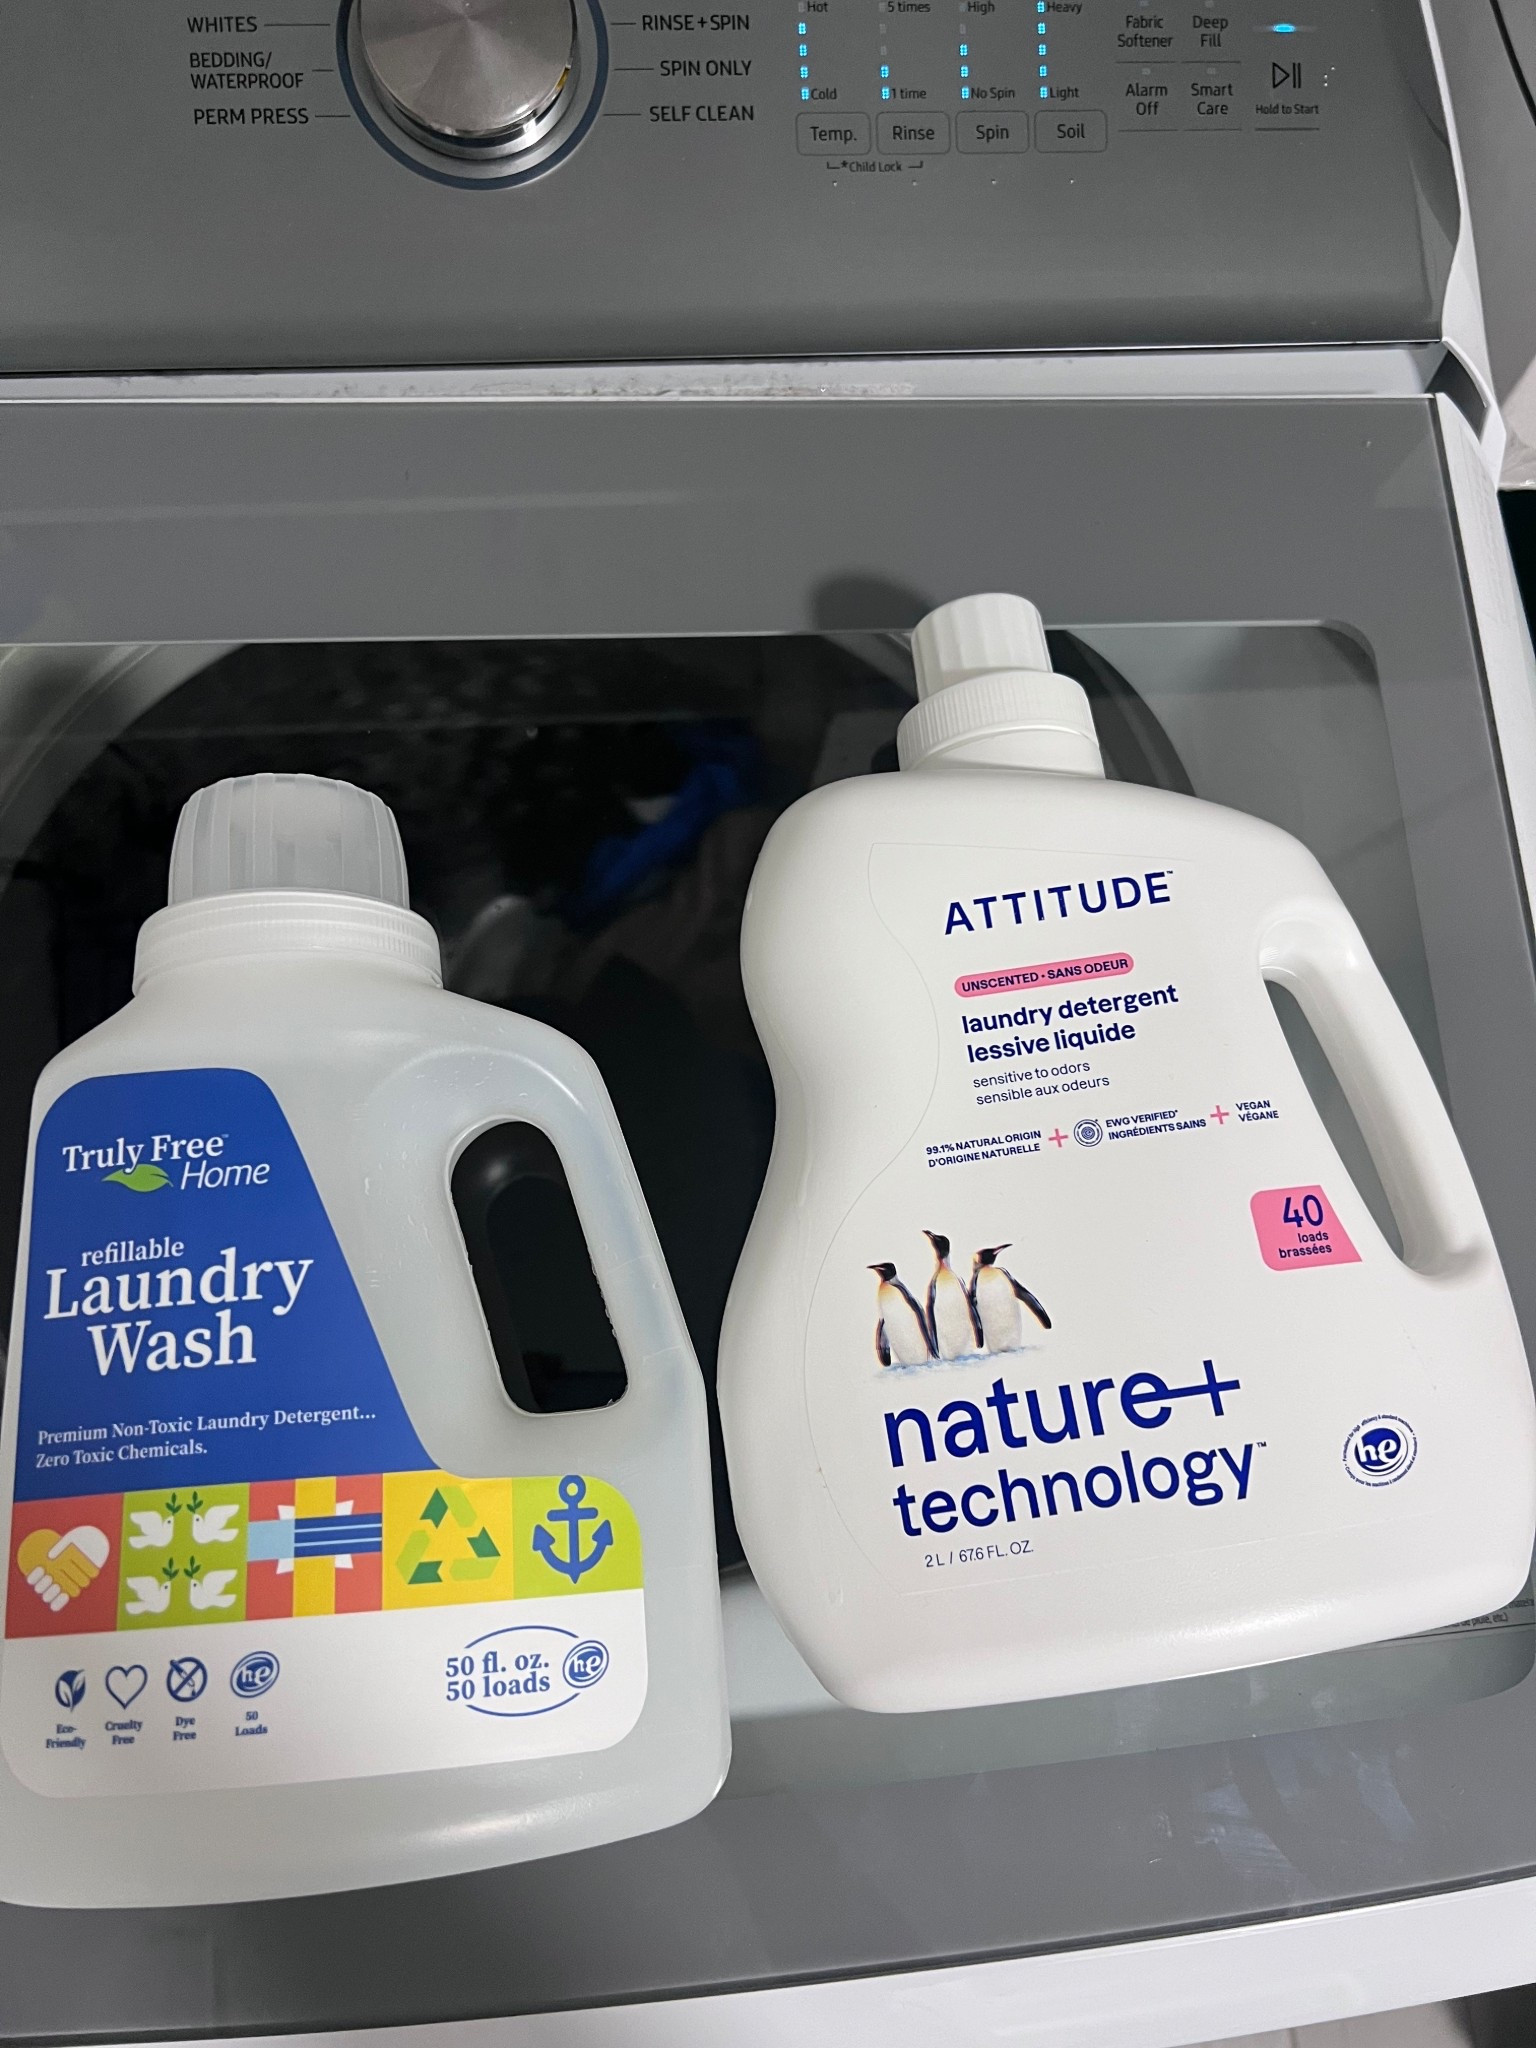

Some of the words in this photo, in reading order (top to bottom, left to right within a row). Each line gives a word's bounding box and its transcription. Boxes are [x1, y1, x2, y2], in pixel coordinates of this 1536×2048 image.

[807, 2, 828, 13] Hot
[888, 1, 895, 13] 5
[898, 1, 931, 13] times
[968, 1, 995, 15] High
[1047, 1, 1082, 15] Heavy
[187, 16, 258, 33] WHITES
[1125, 15, 1164, 29] Fabric
[1193, 15, 1229, 31] Deep
[1117, 33, 1173, 48] Softener
[1201, 33, 1222, 48] Fill
[190, 51, 272, 69] BEDDING/
[660, 60, 700, 76] SPIN
[706, 60, 752, 76] ONLY
[190, 72, 304, 89] WATERPROOF
[811, 88, 838, 100] Cold
[900, 88, 927, 99] time
[971, 87, 987, 99] No
[990, 87, 1015, 100] Spin
[1050, 86, 1079, 101] Light
[1125, 83, 1168, 97] Alarm
[1191, 83, 1233, 97] Smart
[194, 108, 245, 125] PERM
[251, 107, 309, 125] PRESS
[650, 106, 691, 122] SELF
[696, 105, 754, 121] CLEAN
[1136, 102, 1159, 115] Off
[1197, 102, 1229, 115] Care
[1256, 104, 1279, 114] Hold
[1282, 104, 1292, 114] to
[1294, 104, 1319, 114] Start
[810, 126, 857, 145] Temp.
[892, 125, 935, 140] Rinse
[976, 125, 1009, 143] Spin
[1057, 123, 1086, 139] Soil
[878, 161, 903, 172] Lock
[961, 972, 1039, 992] UNSCENTED
[1047, 965, 1082, 980] SANS
[1084, 958, 1129, 974] ODEUR
[962, 1005, 1053, 1034] laundry
[1058, 984, 1179, 1019] detergent
[967, 1035, 1050, 1063] lessive
[1053, 1023, 1136, 1051] liquide
[973, 1069, 1033, 1088] sensitive
[1034, 1067, 1049, 1079] to
[1051, 1060, 1090, 1077] odors
[976, 1086, 1033, 1105] sensible
[1035, 1084, 1060, 1097] aux
[1061, 1076, 1110, 1093] odeurs
[1236, 1100, 1271, 1111] VEGAN
[1106, 1117, 1130, 1128] EWG
[1238, 1110, 1279, 1122] VÉGANE
[1108, 1123, 1175, 1140] INGRÉDIENTS
[1176, 1118, 1207, 1131] SAINS
[926, 1143, 955, 1155] 99.1%
[955, 1136, 1005, 1152] NATURAL
[1005, 1130, 1041, 1143] ORIGIN
[62, 1138, 144, 1173] Truly
[928, 1151, 980, 1168] D'ORIGINE
[981, 1143, 1041, 1160] NATURELLE
[180, 1160, 270, 1190] Home
[1283, 1194, 1324, 1228] 40
[1298, 1231, 1329, 1243] loads
[81, 1236, 185, 1267] refillable
[1279, 1244, 1332, 1259] brassées
[44, 1246, 314, 1320] Laundry
[87, 1308, 257, 1376] Wash
[38, 1426, 107, 1446] Premium
[111, 1417, 193, 1438] Non-Toxic
[197, 1412, 269, 1432] Laundry
[273, 1406, 376, 1428] Detergent...
[35, 1453, 70, 1469] Zero
[73, 1446, 115, 1465] Toxic
[117, 1439, 208, 1461] Chemicals.
[924, 1554, 934, 1568] 2
[936, 1553, 945, 1566] L
[987, 1544, 1008, 1559] FL.
[1010, 1540, 1034, 1555] OZ.
[445, 1656, 475, 1678] 50
[482, 1650, 507, 1674] fl.
[515, 1653, 550, 1671] oz.
[446, 1679, 476, 1701] 50
[482, 1671, 551, 1698] loads
[175, 1716, 196, 1729] Dye
[246, 1711, 258, 1721] 50
[105, 1719, 143, 1733] Cruelty
[235, 1724, 268, 1736] Loads
[112, 1734, 135, 1745] Free
[173, 1730, 197, 1742] Free
[46, 1737, 86, 1751] Friendly
